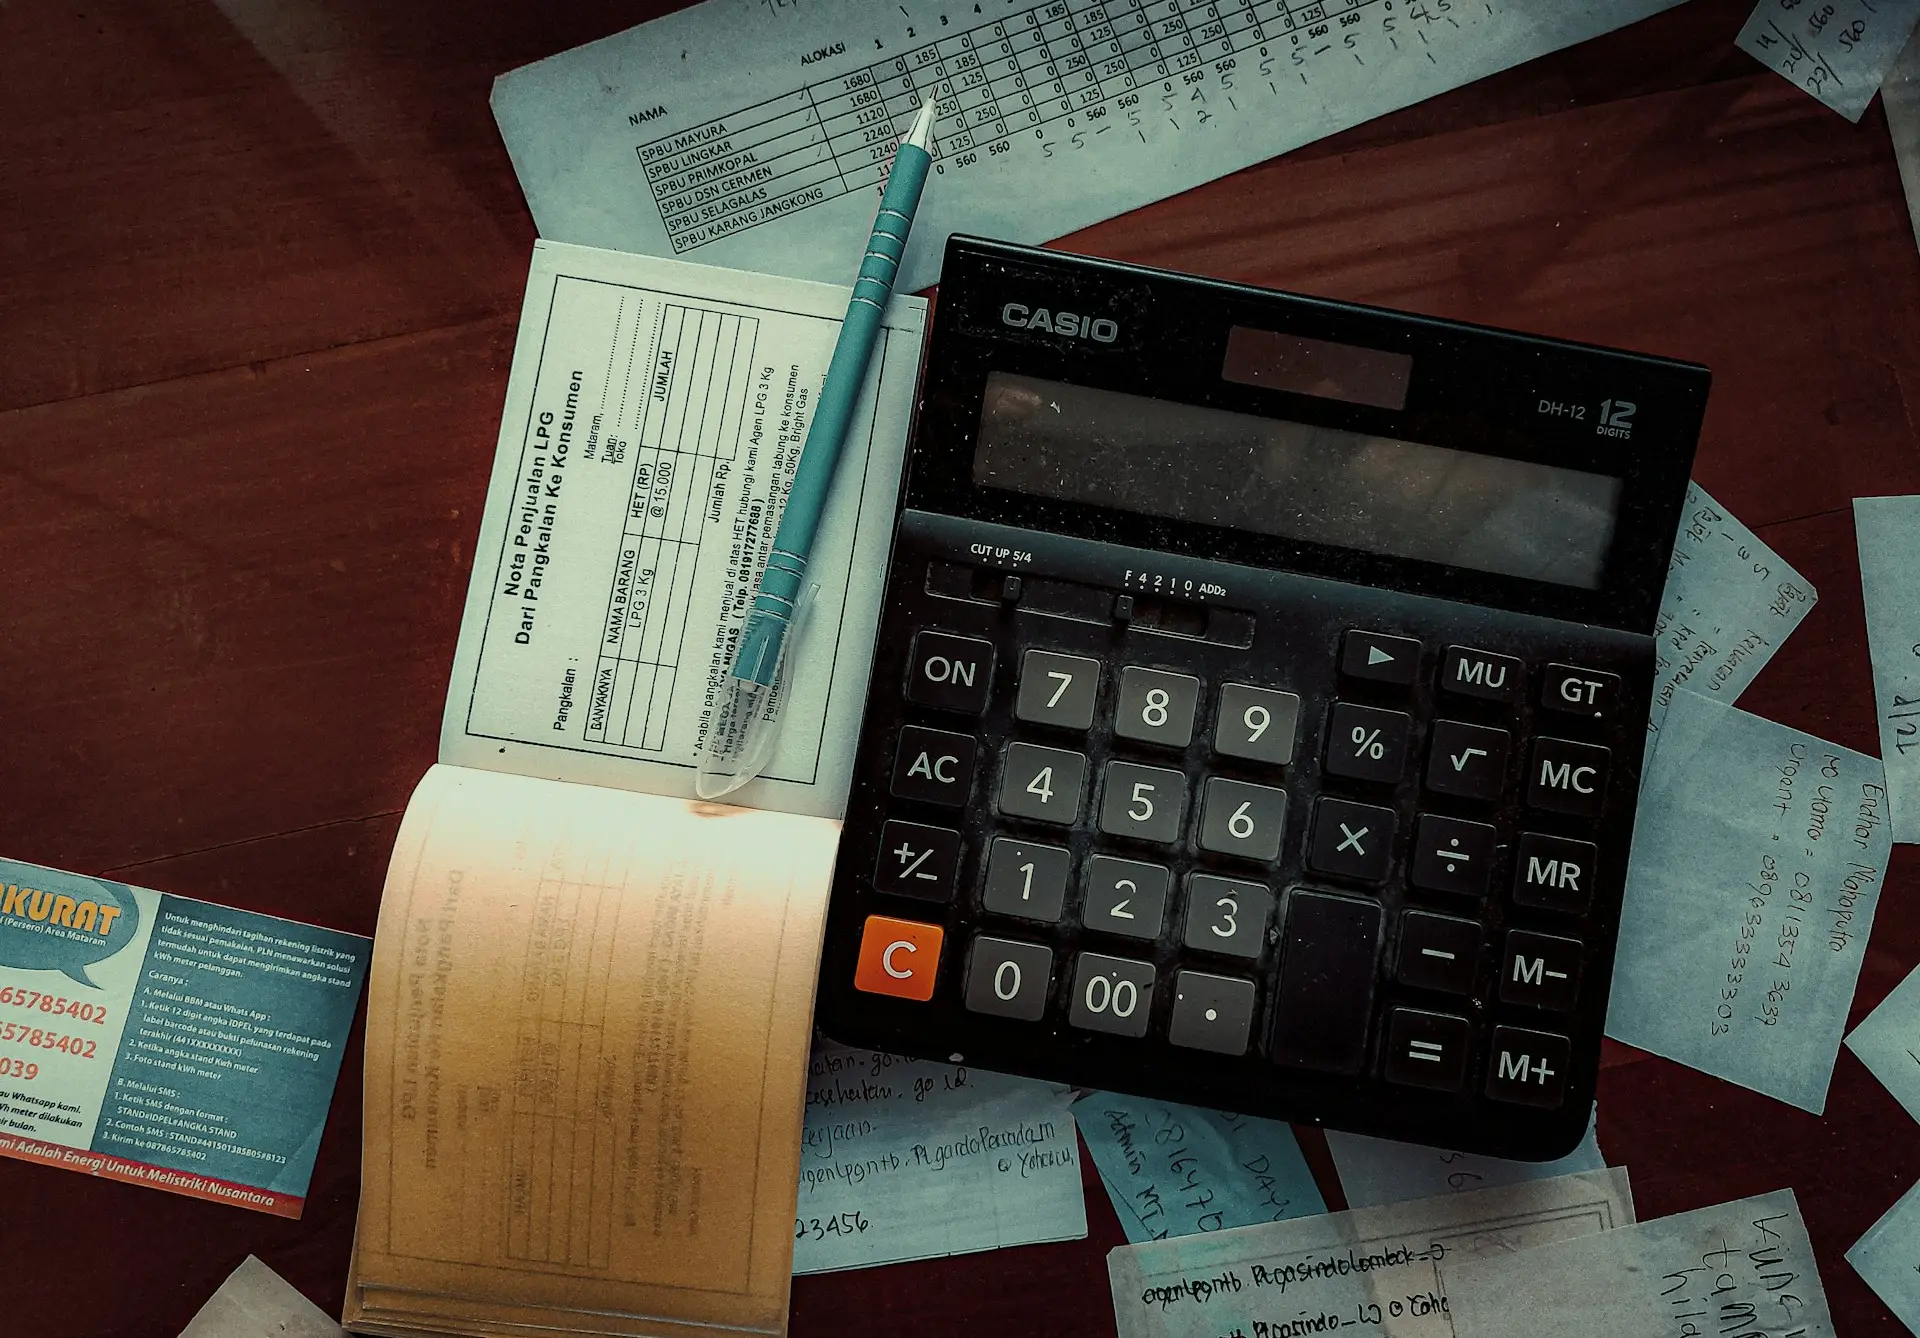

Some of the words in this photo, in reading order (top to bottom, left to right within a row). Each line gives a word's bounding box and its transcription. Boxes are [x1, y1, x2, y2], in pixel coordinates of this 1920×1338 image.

[874, 39, 883, 50] 1
[906, 27, 916, 38] 2
[940, 15, 949, 26] 3
[973, 3, 982, 14] 4
[801, 41, 846, 66] ALOKASI
[641, 140, 672, 161] SPBU
[673, 123, 728, 149] MAYURA
[843, 73, 870, 91] 1680
[915, 49, 937, 65] 185
[1046, 5, 1065, 19] 185
[627, 104, 668, 126] NAMA
[647, 157, 679, 179] SPBU
[680, 139, 733, 167] LINGKAR
[850, 90, 878, 108] 1680
[955, 54, 976, 70] 185
[955, 153, 978, 168] 560
[989, 141, 1010, 156] 560
[1086, 107, 1107, 122] 560
[1117, 94, 1139, 110] 560
[1183, 70, 1205, 86] 560
[1215, 58, 1236, 74] 560
[654, 175, 686, 196] SPBU
[686, 152, 758, 184] PRIMKOPAL
[857, 107, 884, 126] 1120
[962, 72, 984, 87] 125
[661, 193, 692, 214] SPBU
[693, 183, 720, 202] DSN
[720, 165, 772, 192] CERMEN
[863, 124, 891, 142] 2240
[667, 210, 699, 231] SPBU
[700, 186, 767, 220] SELAGALAS
[870, 142, 898, 160] 2240
[975, 105, 997, 122] 250
[674, 227, 706, 249] SPBU
[706, 210, 758, 237] KARANG
[760, 189, 825, 218] JANGKONG
[1002, 302, 1118, 343] CASIO
[653, 350, 673, 402] JUMLAH
[757, 382, 769, 390] 3
[759, 366, 774, 381] Kg
[781, 364, 798, 416] konsumen
[753, 392, 767, 415] LPG
[795, 388, 808, 408] Gas
[1537, 399, 1586, 421] DH-12
[1599, 398, 1637, 429] 12
[533, 411, 554, 450] LPG
[549, 370, 583, 468] Konsumen
[583, 412, 604, 459] Mataram,
[748, 417, 763, 446] Agen
[778, 419, 789, 431] ke
[789, 410, 805, 443] Bright
[1596, 425, 1631, 440] DIGITS
[614, 440, 627, 464] Toko
[743, 446, 758, 472] kami
[772, 434, 789, 469] tabung
[544, 473, 562, 498] Ke
[636, 462, 654, 490] (RP)
[653, 462, 672, 502] 15.000
[715, 461, 732, 479] Rp.
[513, 456, 546, 547] Penjualan
[630, 491, 646, 518] HET
[708, 481, 726, 523] Jumlah
[736, 473, 755, 515] hubungi
[761, 472, 780, 538] pemasangan
[731, 516, 745, 541] HET
[522, 503, 557, 601] Pangkalan
[728, 543, 741, 566] atas
[970, 543, 993, 556] CUT
[995, 547, 1011, 559] UP
[1012, 551, 1033, 564] 5/4
[502, 552, 526, 596] Nota
[614, 549, 635, 604] BARANG
[638, 568, 655, 586] Kg
[725, 567, 736, 578] di
[1124, 570, 1133, 581] F
[1138, 572, 1148, 584] 4
[1154, 575, 1163, 587] 2
[1170, 577, 1177, 589] 1
[1184, 580, 1193, 591] 0
[635, 588, 648, 597] 3
[719, 579, 734, 622] menjual
[732, 586, 747, 610] Telp.
[514, 605, 536, 644] Dari
[605, 606, 625, 644] NAMA
[628, 599, 649, 628] LPG
[711, 623, 726, 649] kami
[703, 651, 721, 707] pangkalan
[924, 655, 976, 687] ON
[1456, 657, 1506, 688] MU
[552, 667, 576, 731] Pangkalan
[589, 668, 612, 730] BANYAKNYA
[1045, 671, 1074, 708] 7
[1141, 688, 1170, 728] 8
[1243, 705, 1271, 743] 9
[1560, 677, 1603, 705] GT
[906, 751, 959, 783] AC
[1540, 760, 1597, 794] MC
[1026, 766, 1054, 804] 4
[1127, 782, 1156, 821] 5
[1227, 801, 1255, 839] 6
[1526, 857, 1582, 891] MR
[0, 883, 121, 936] KURAT
[1018, 862, 1035, 900] 1
[1109, 879, 1137, 919] 2
[1210, 898, 1239, 938] 3
[3, 916, 44, 933] (Persero)
[44, 925, 65, 937] Area
[66, 930, 106, 947] Mataram
[164, 911, 189, 924] Untuk
[189, 919, 242, 936] menghindari
[241, 929, 275, 944] tagihan
[273, 937, 310, 953] rekening
[310, 944, 334, 956] listrik
[334, 951, 355, 962] yang
[882, 940, 918, 979] C
[1, 985, 108, 1026] 65785402
[993, 960, 1021, 1001] 0
[1085, 975, 1137, 1018] 00
[1499, 1051, 1555, 1085] M+
[9, 1107, 38, 1118] meter
[37, 1111, 83, 1128] dilakukan
[11, 1091, 56, 1109] Whatsapp
[56, 1101, 81, 1114] kami.
[8, 1118, 36, 1132] bulan.
[14, 1140, 62, 1160] Adalah
[62, 1150, 106, 1171] Energi
[106, 1159, 146, 1178] Untuk
[145, 1168, 208, 1191] Melistriki
[206, 1181, 274, 1206] Nusantara
